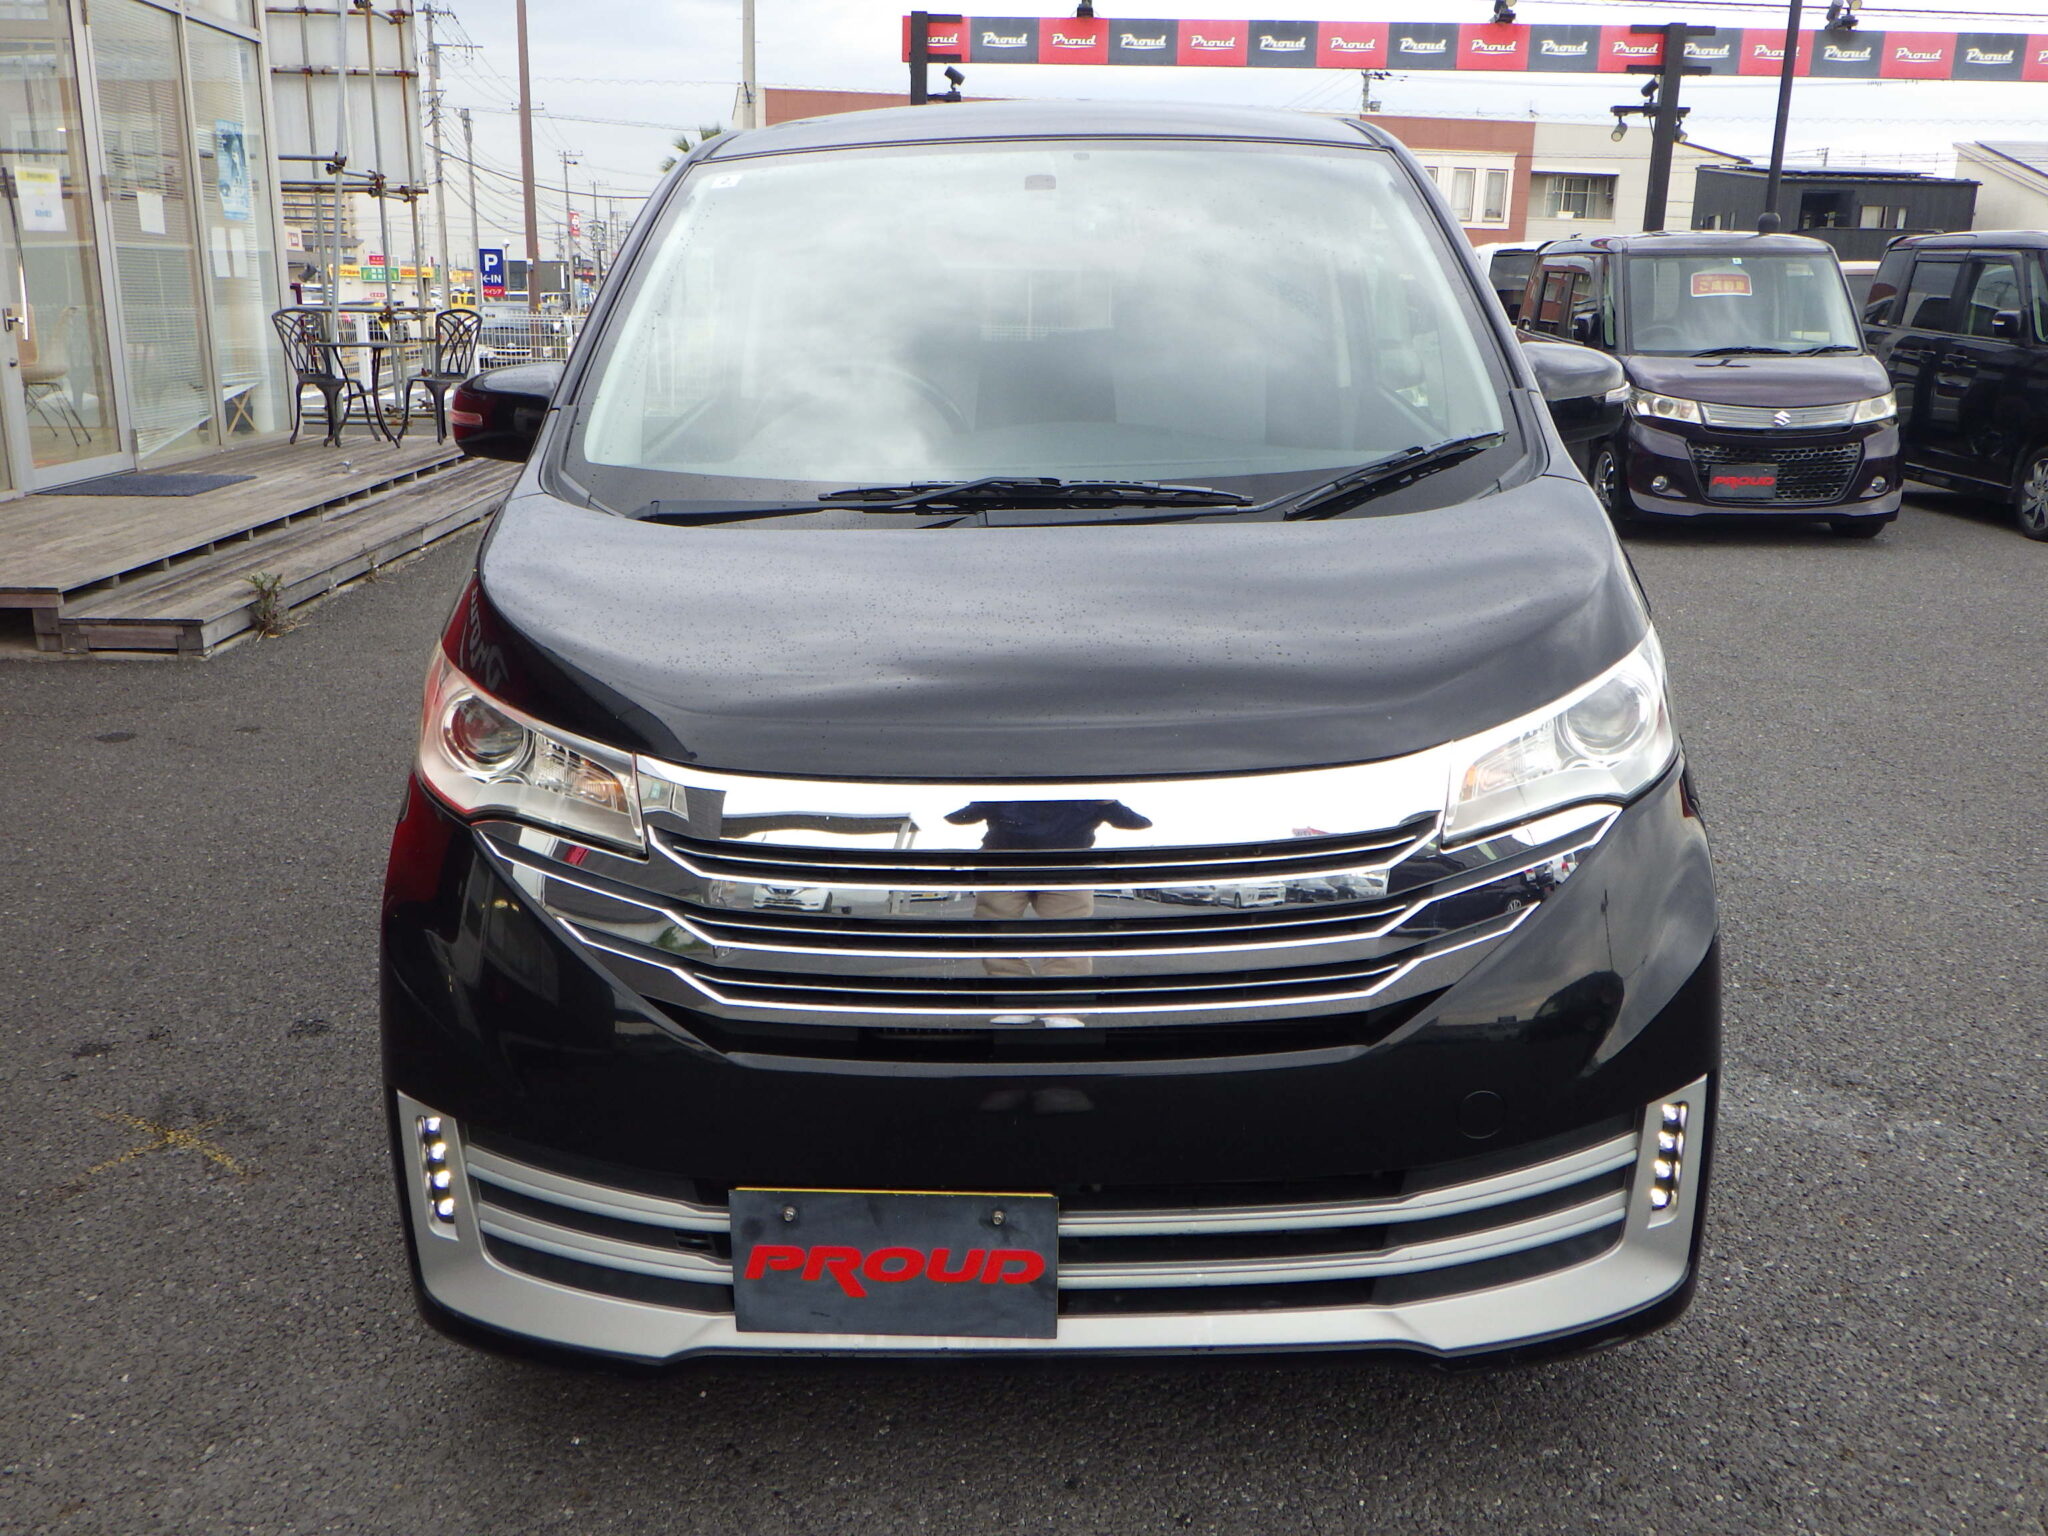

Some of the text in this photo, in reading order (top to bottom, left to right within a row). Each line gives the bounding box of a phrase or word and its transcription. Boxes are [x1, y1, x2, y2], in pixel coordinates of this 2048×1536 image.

[983, 32, 1028, 45] Proud
[1052, 33, 1096, 45] Proud
[1120, 34, 1166, 46] Proud
[1191, 35, 1236, 47] Proud
[1260, 35, 1306, 48] Proud
[1331, 37, 1375, 49] Proud
[1400, 38, 1446, 50] Proud
[1472, 39, 1516, 51] Proud
[1541, 40, 1588, 53] Proud
[1612, 41, 1658, 54] Proud
[1684, 42, 1730, 55] Proud
[1824, 45, 1872, 58] Proud
[1896, 47, 1942, 59] Proud
[1966, 48, 2013, 61] Proud
[484, 253, 498, 271] P
[491, 274, 502, 283] IN
[1711, 476, 1776, 490] PROUD
[744, 1245, 1046, 1298] PROUD
